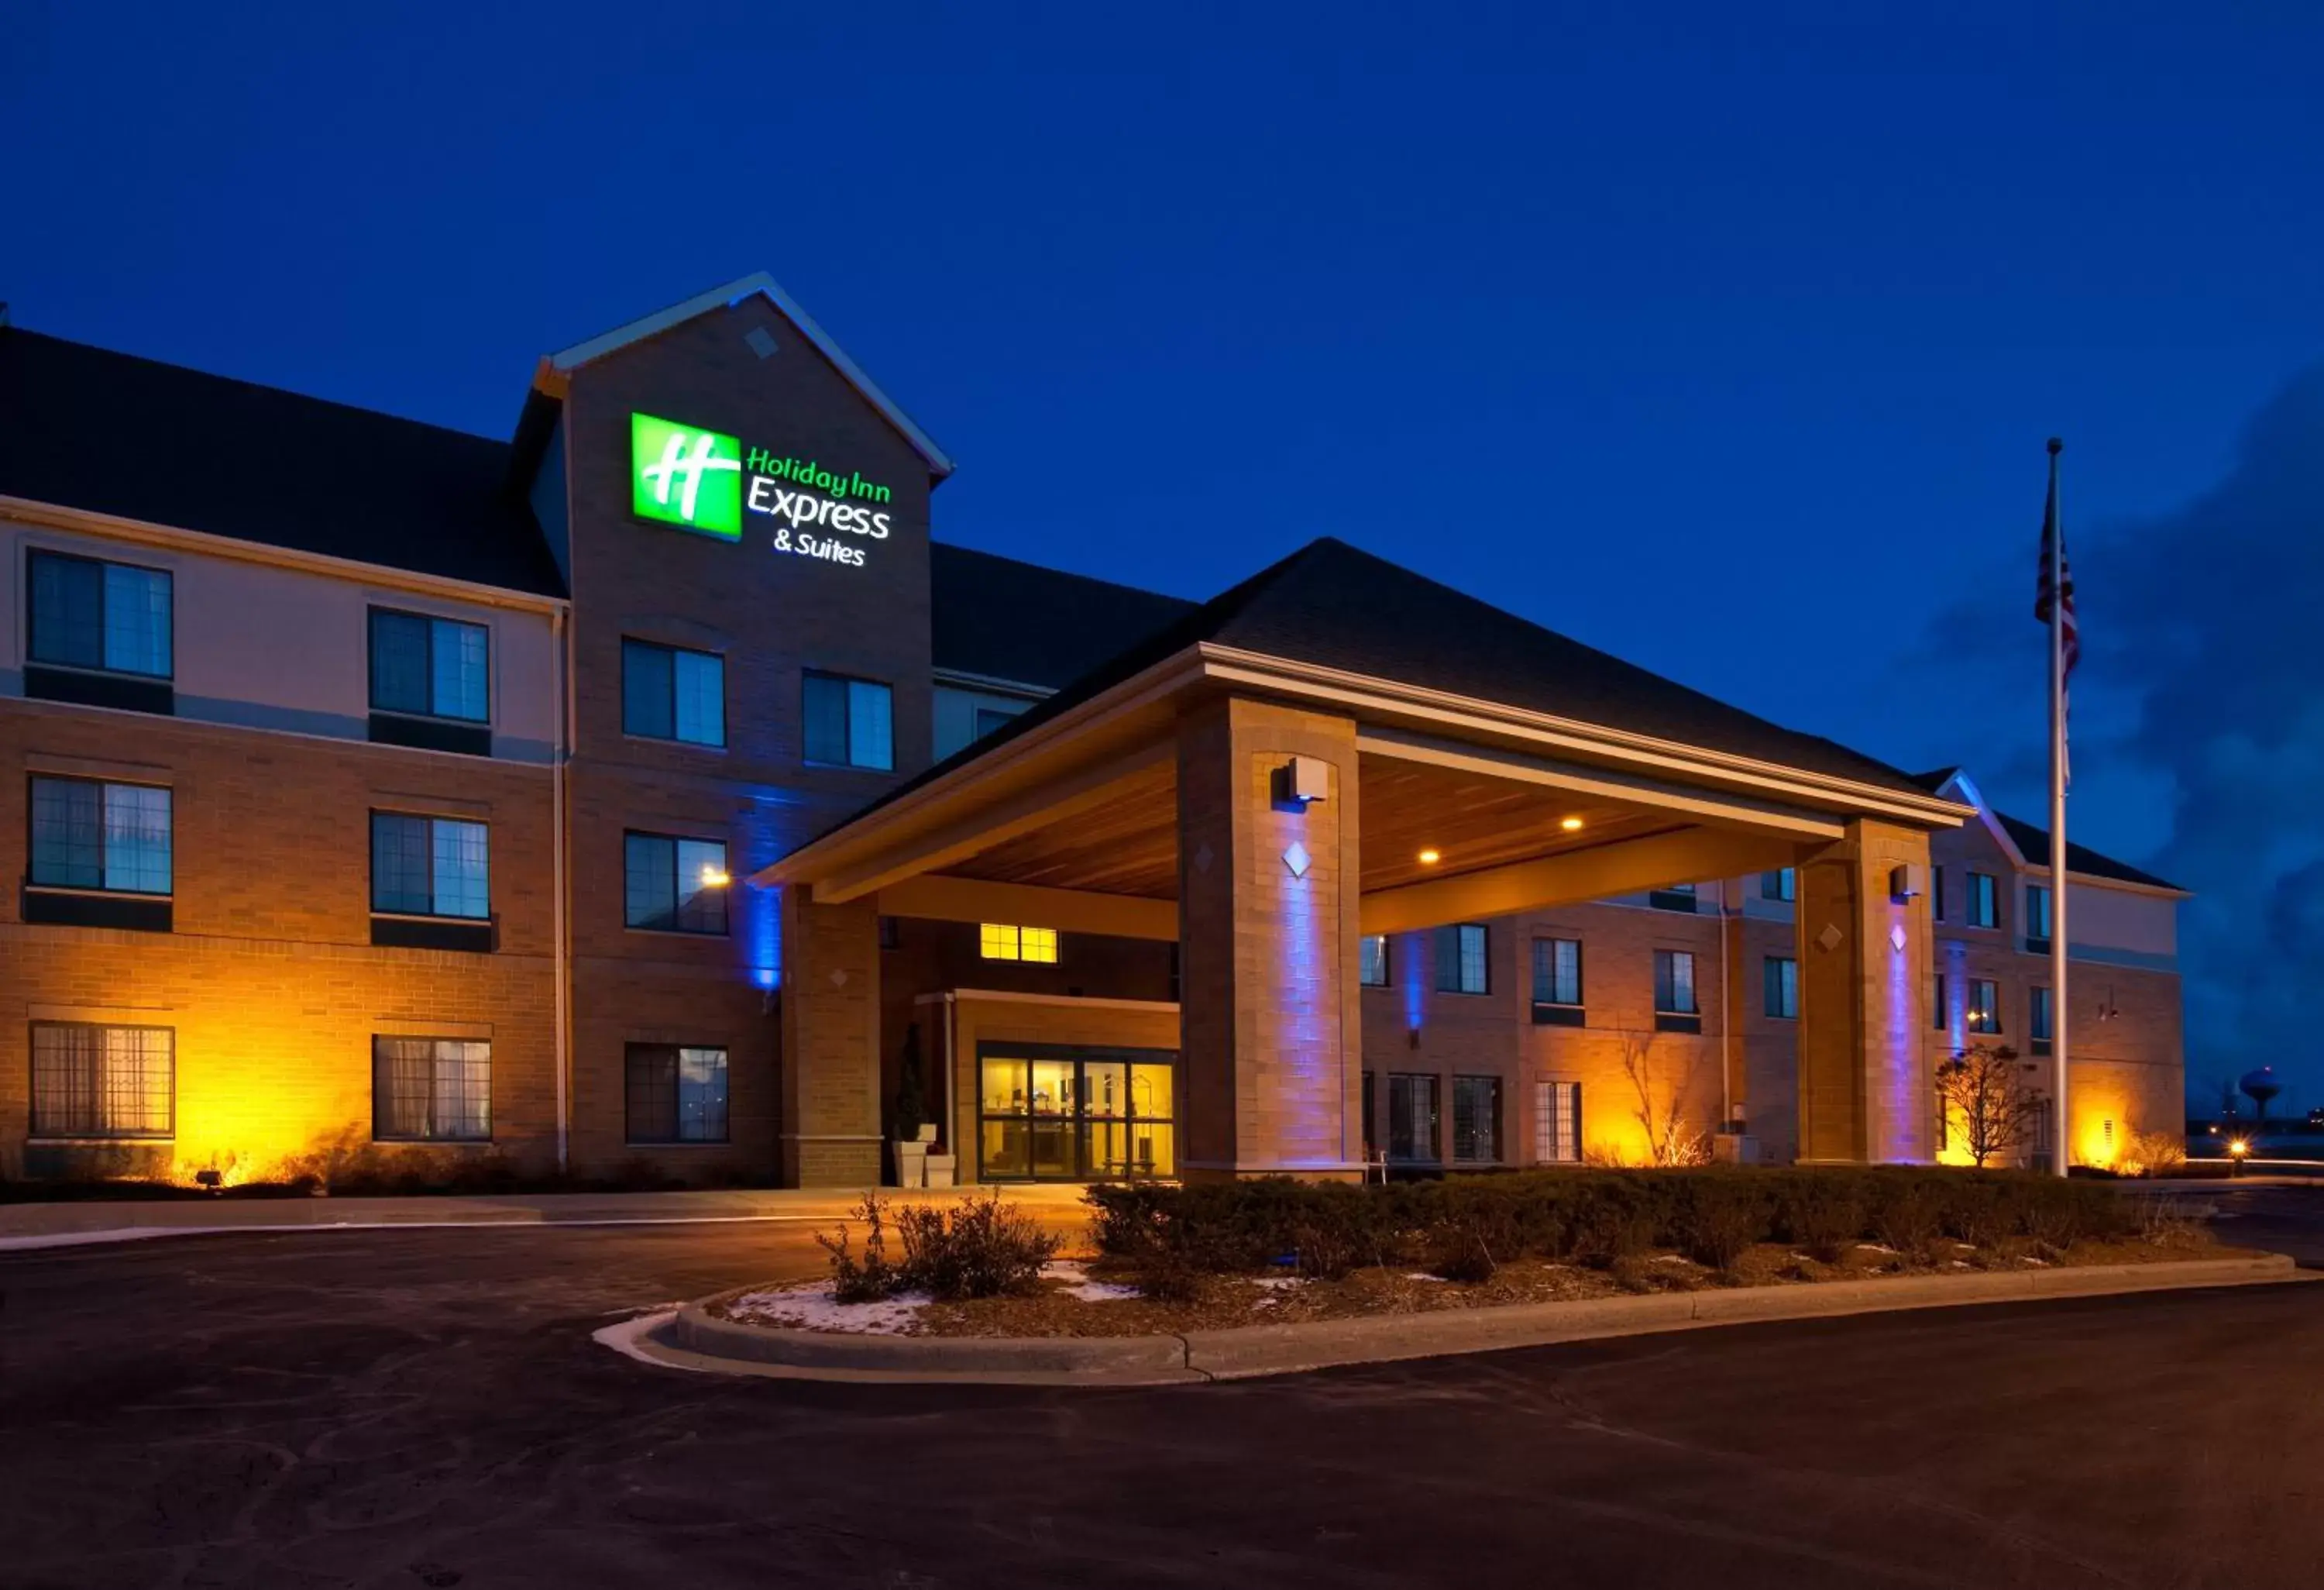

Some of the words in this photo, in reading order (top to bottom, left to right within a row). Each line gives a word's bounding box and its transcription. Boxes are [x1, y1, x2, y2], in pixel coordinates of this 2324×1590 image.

[642, 433, 741, 521] H
[747, 446, 849, 498] Holiday
[851, 472, 891, 504] Inn
[748, 475, 891, 538] Express
[775, 528, 792, 552] &
[795, 533, 865, 566] Suites
